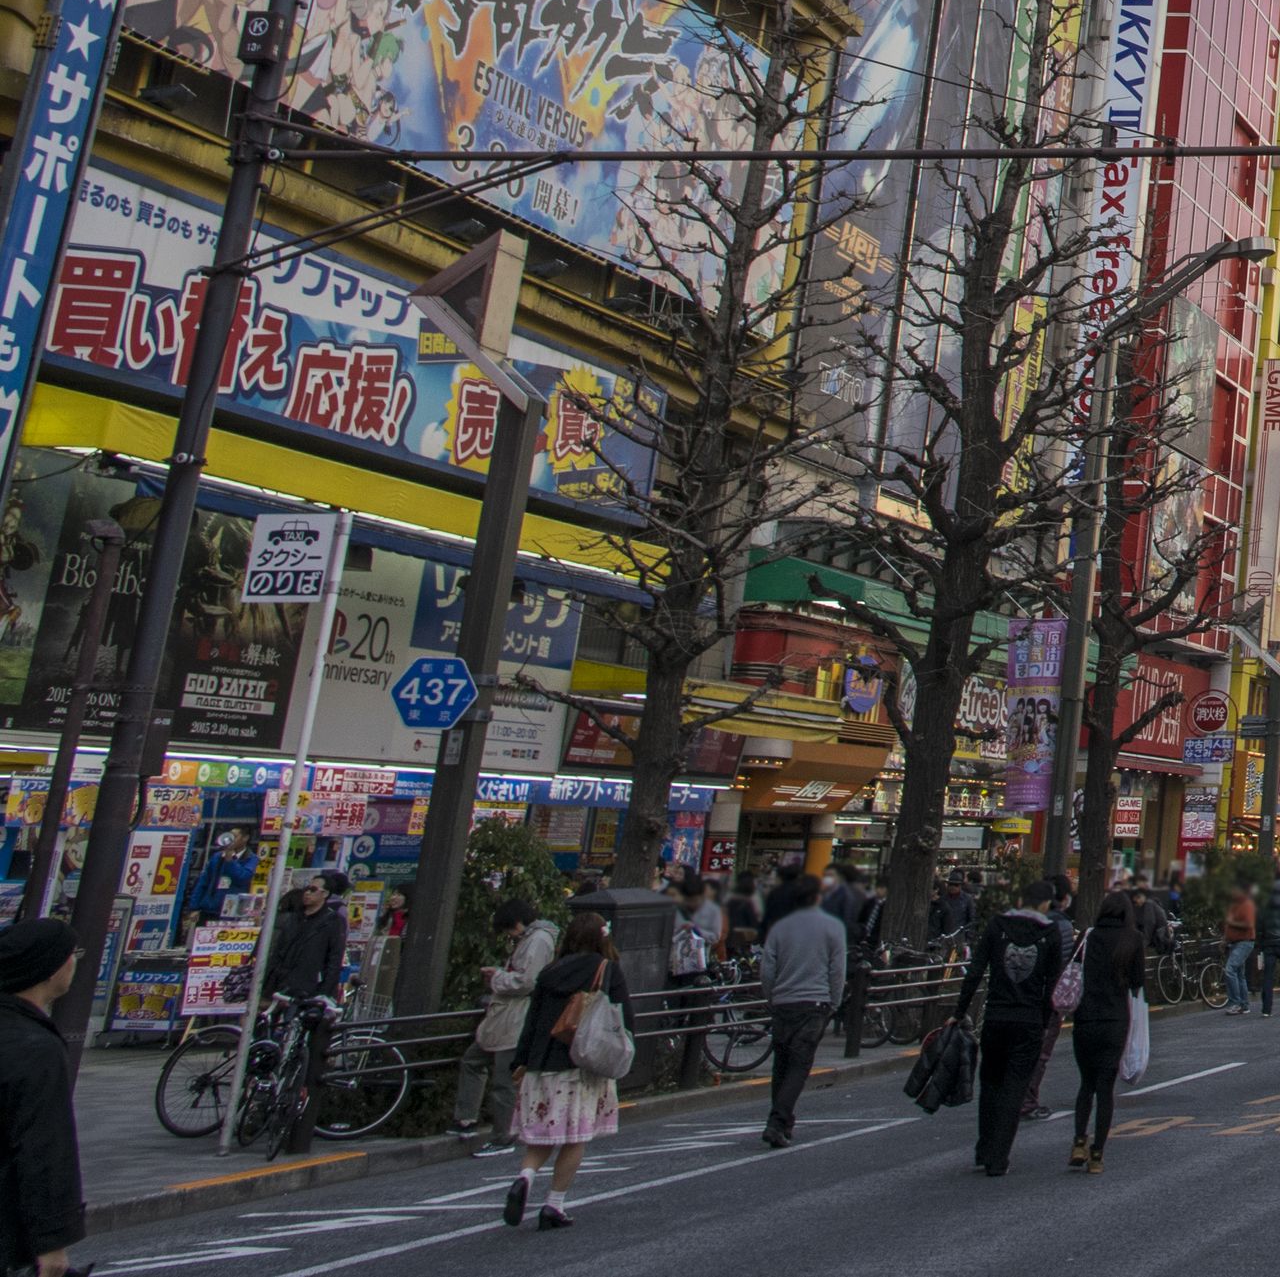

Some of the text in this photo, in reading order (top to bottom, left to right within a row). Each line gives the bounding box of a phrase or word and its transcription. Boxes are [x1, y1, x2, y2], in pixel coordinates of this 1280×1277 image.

[475, 60, 588, 149] ESTIVAL VERSUS
[1100, 139, 1140, 214] Tax
[534, 177, 579, 226] 開幕!
[0, 64, 91, 373] サポートも
[136, 200, 194, 240] 買うのも
[1088, 231, 1130, 320] free
[283, 530, 305, 542] TAXI
[256, 548, 322, 567] タクシー
[250, 571, 323, 596] のりば
[349, 614, 395, 665] 20th
[184, 673, 267, 699] GOD EATER
[308, 659, 392, 689] nniversary
[400, 678, 467, 706] 437
[1195, 707, 1226, 722] 消火栓
[153, 788, 193, 802] 中古ソフト
[476, 781, 529, 803] ください!!
[796, 779, 836, 802] Hey
[1119, 799, 1141, 808] GAME
[1116, 825, 1140, 836] GAME
[135, 972, 178, 983] ソフマップ
